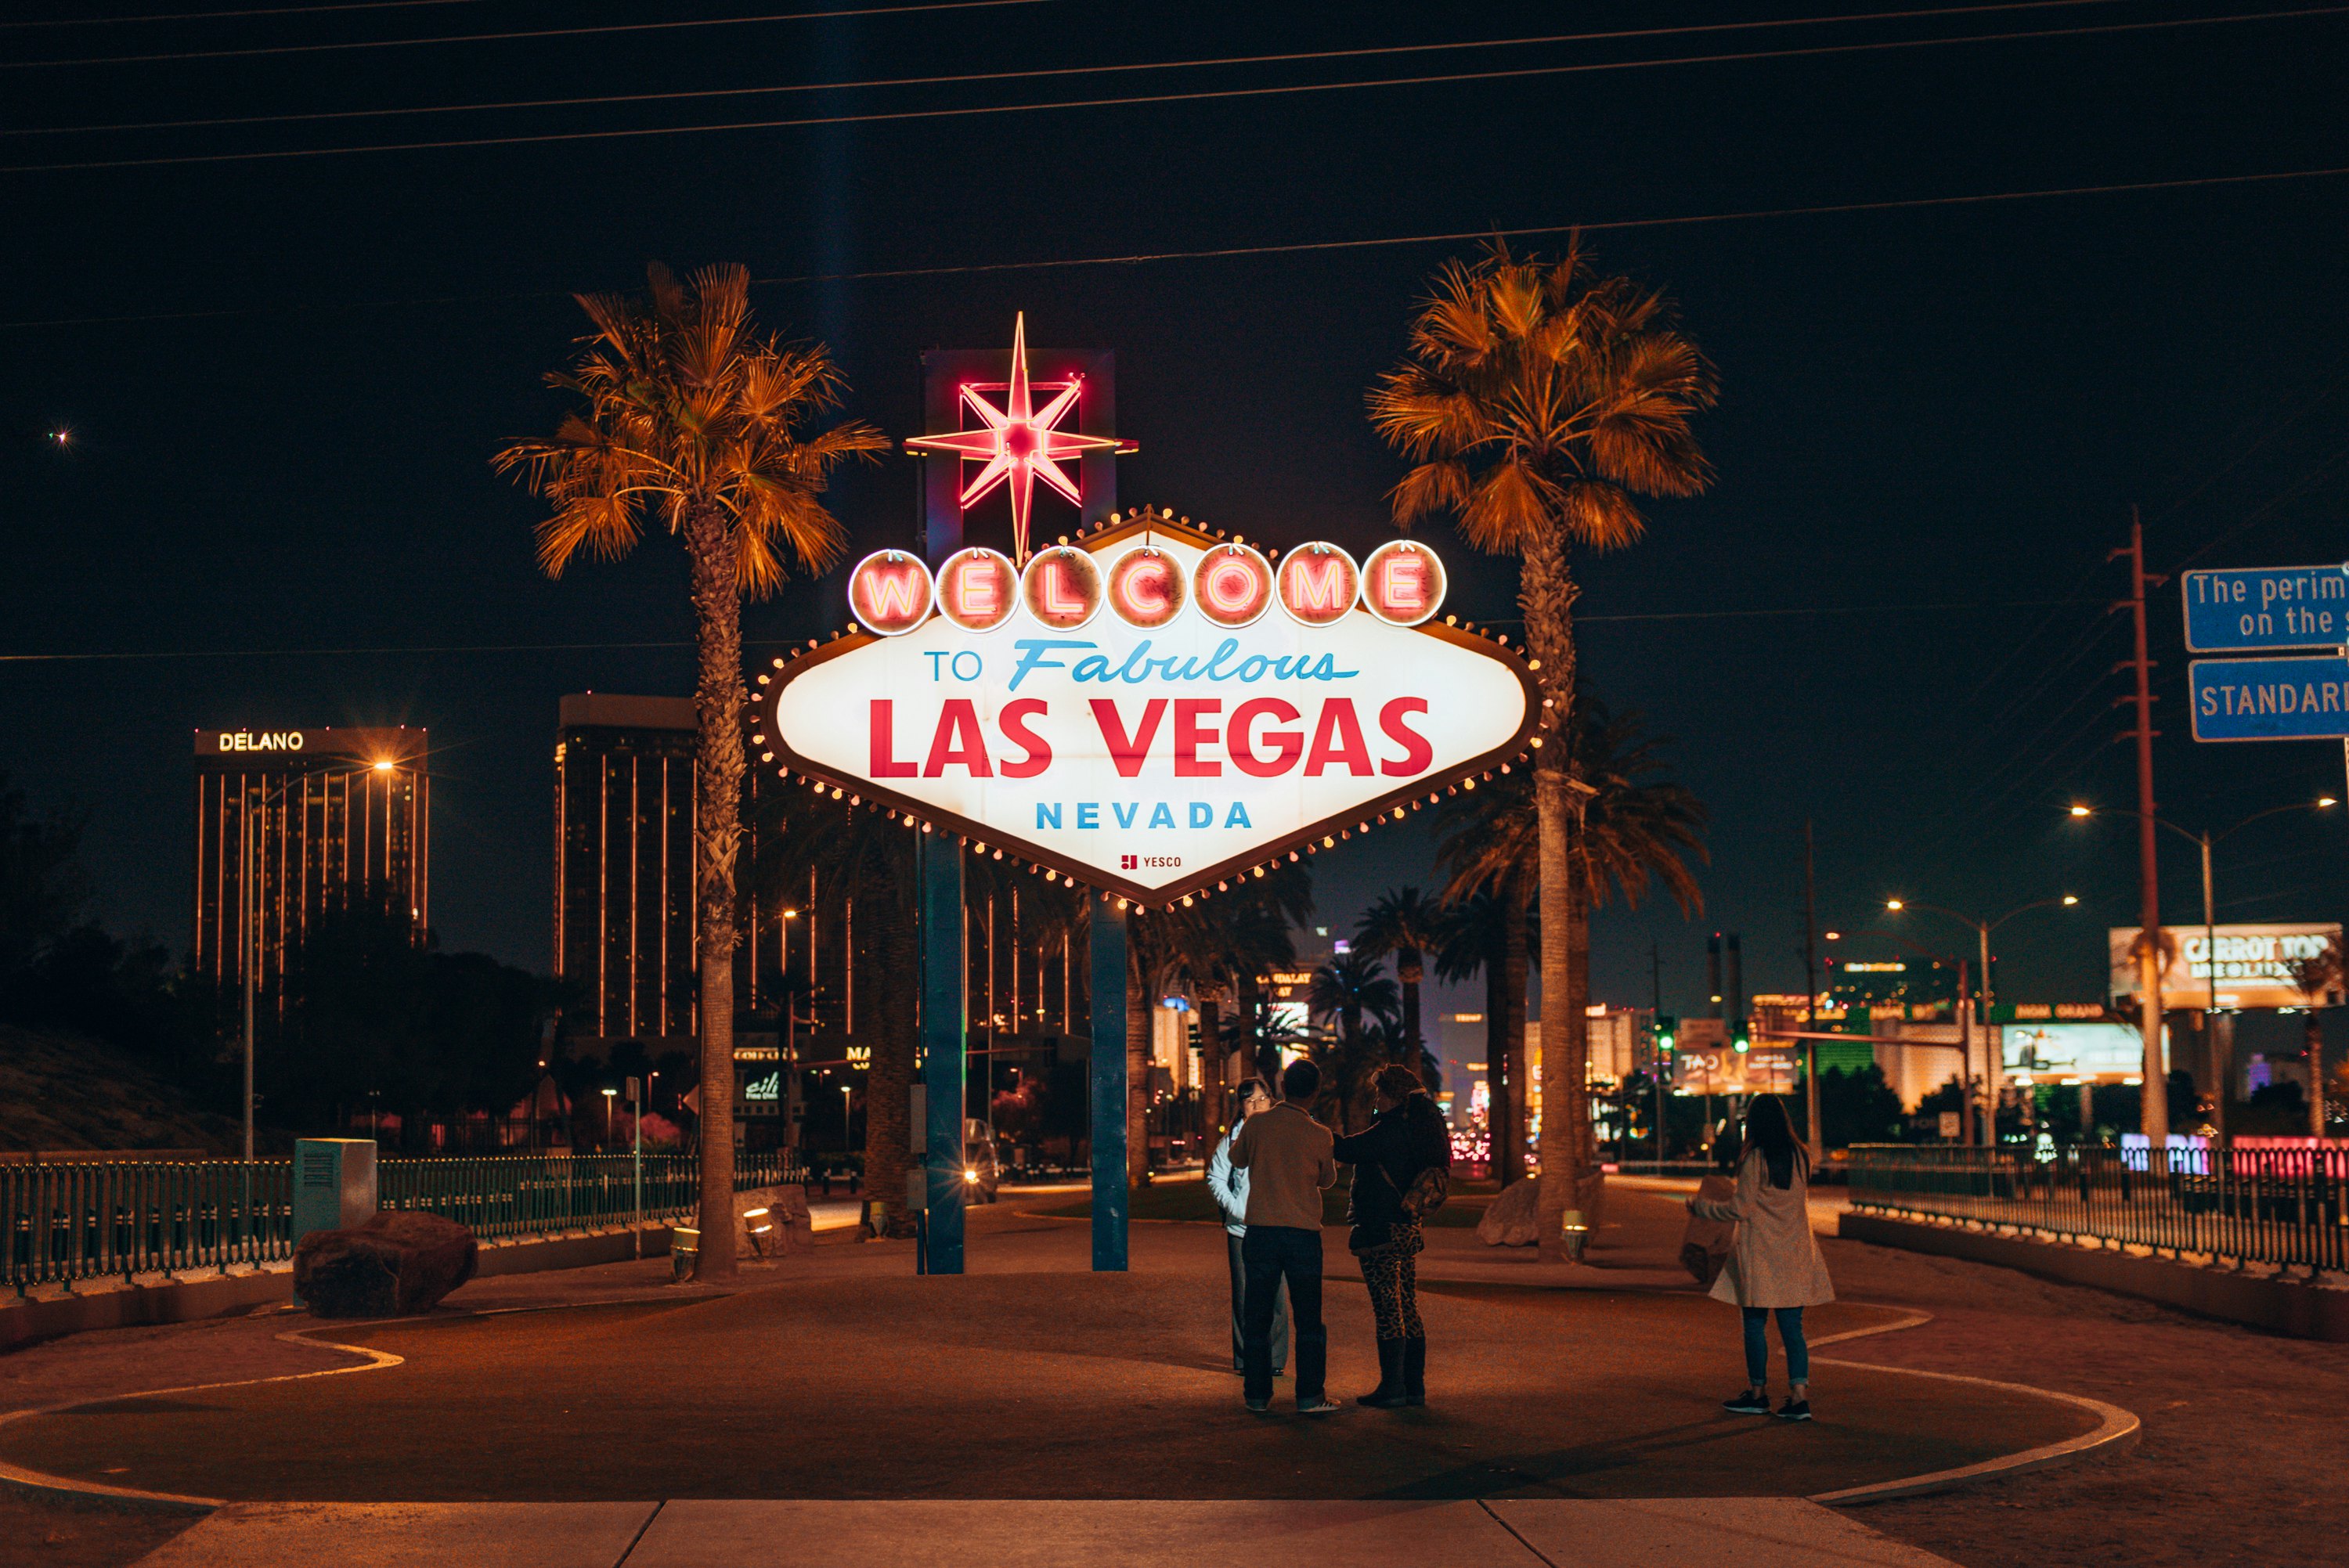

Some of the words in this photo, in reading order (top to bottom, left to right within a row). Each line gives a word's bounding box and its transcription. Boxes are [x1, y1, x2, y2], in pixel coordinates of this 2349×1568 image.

[864, 557, 1422, 618] WELCOME
[2192, 575, 2246, 604] The
[2239, 613, 2273, 636] on
[2286, 606, 2333, 634] the
[924, 651, 983, 682] TO
[1008, 638, 1360, 692] Fabulous
[219, 731, 304, 752] DELANO
[869, 697, 1053, 778] LAS
[1088, 697, 1434, 778] VEGAS
[1036, 802, 1252, 829] NEVADA
[1143, 856, 1182, 867] YESCO
[2183, 935, 2276, 963] CARROT
[2279, 935, 2329, 960] TOP
[1680, 1054, 1719, 1071] TAO
[745, 1071, 779, 1093] cili
